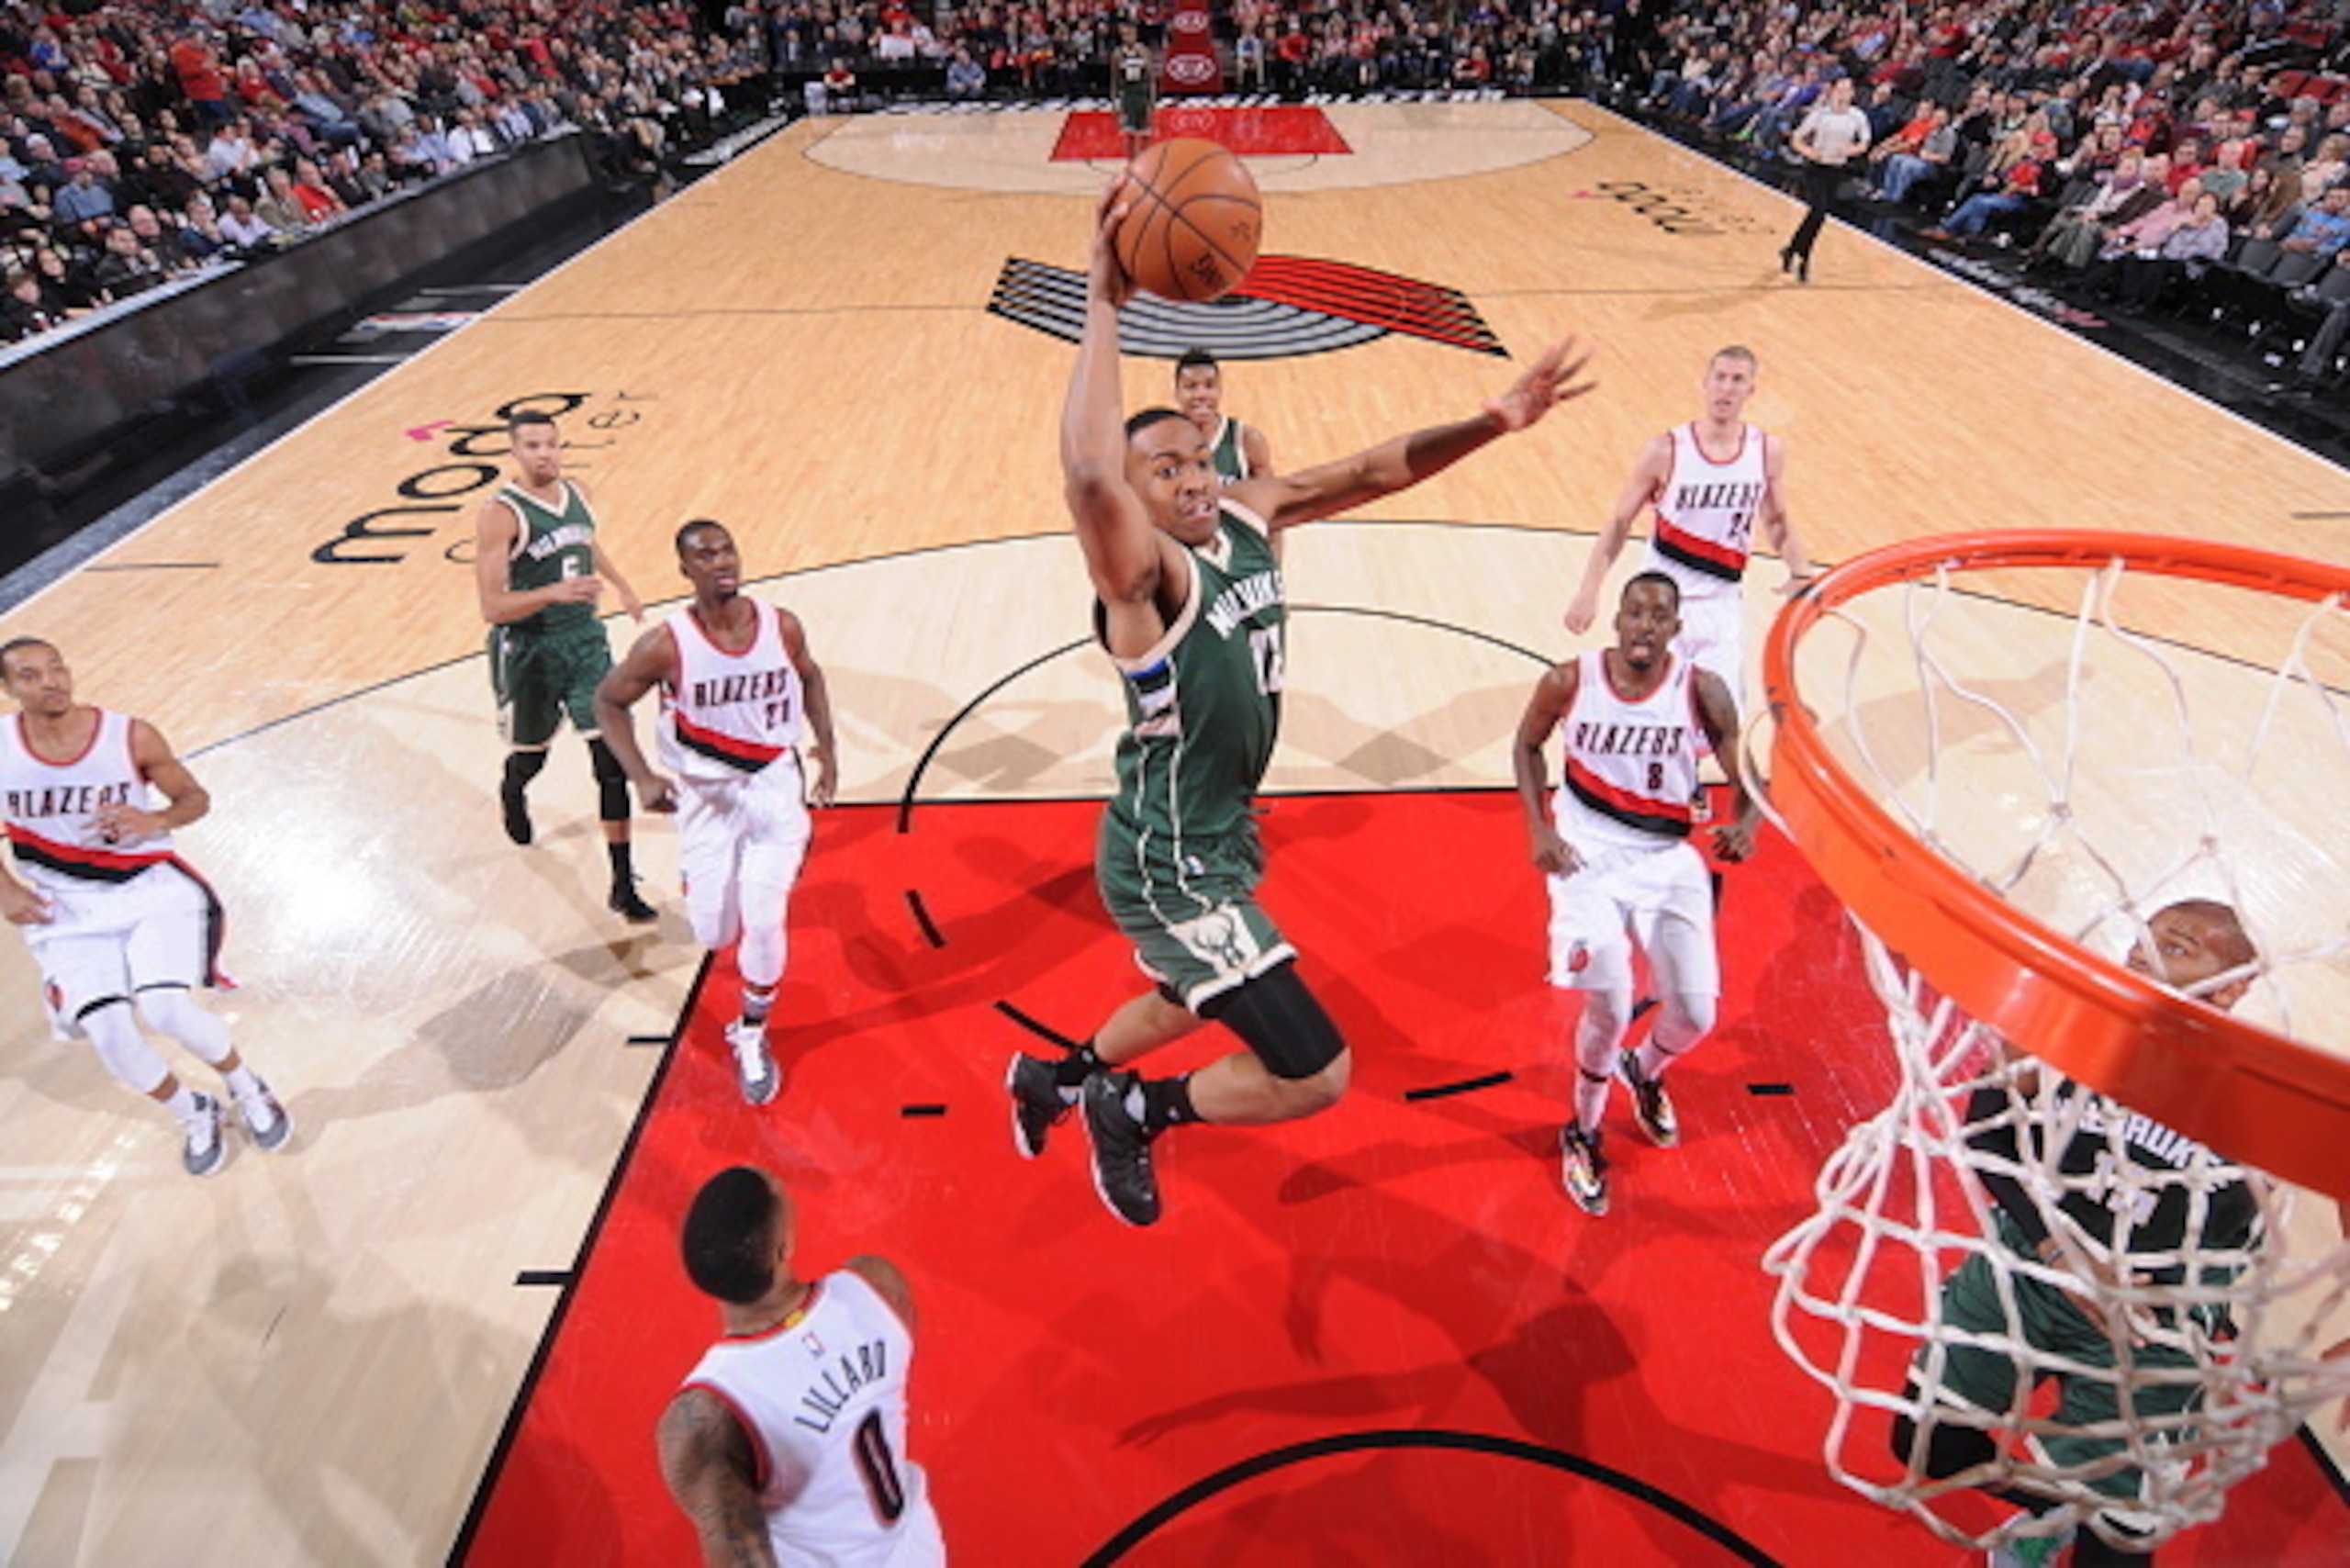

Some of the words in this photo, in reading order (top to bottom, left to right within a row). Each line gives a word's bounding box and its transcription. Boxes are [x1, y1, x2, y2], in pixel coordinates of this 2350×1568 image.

[1169, 59, 1213, 78] KIA
[1676, 480, 1762, 510] BLAZERS
[694, 667, 788, 707] BLAZERS
[765, 699, 790, 730] 21
[1575, 722, 1684, 755] BLAZERS
[1647, 763, 1663, 790] 8
[7, 782, 131, 817] BLAZERS
[794, 1339, 886, 1434] LILLARD
[853, 1405, 904, 1527] 0
